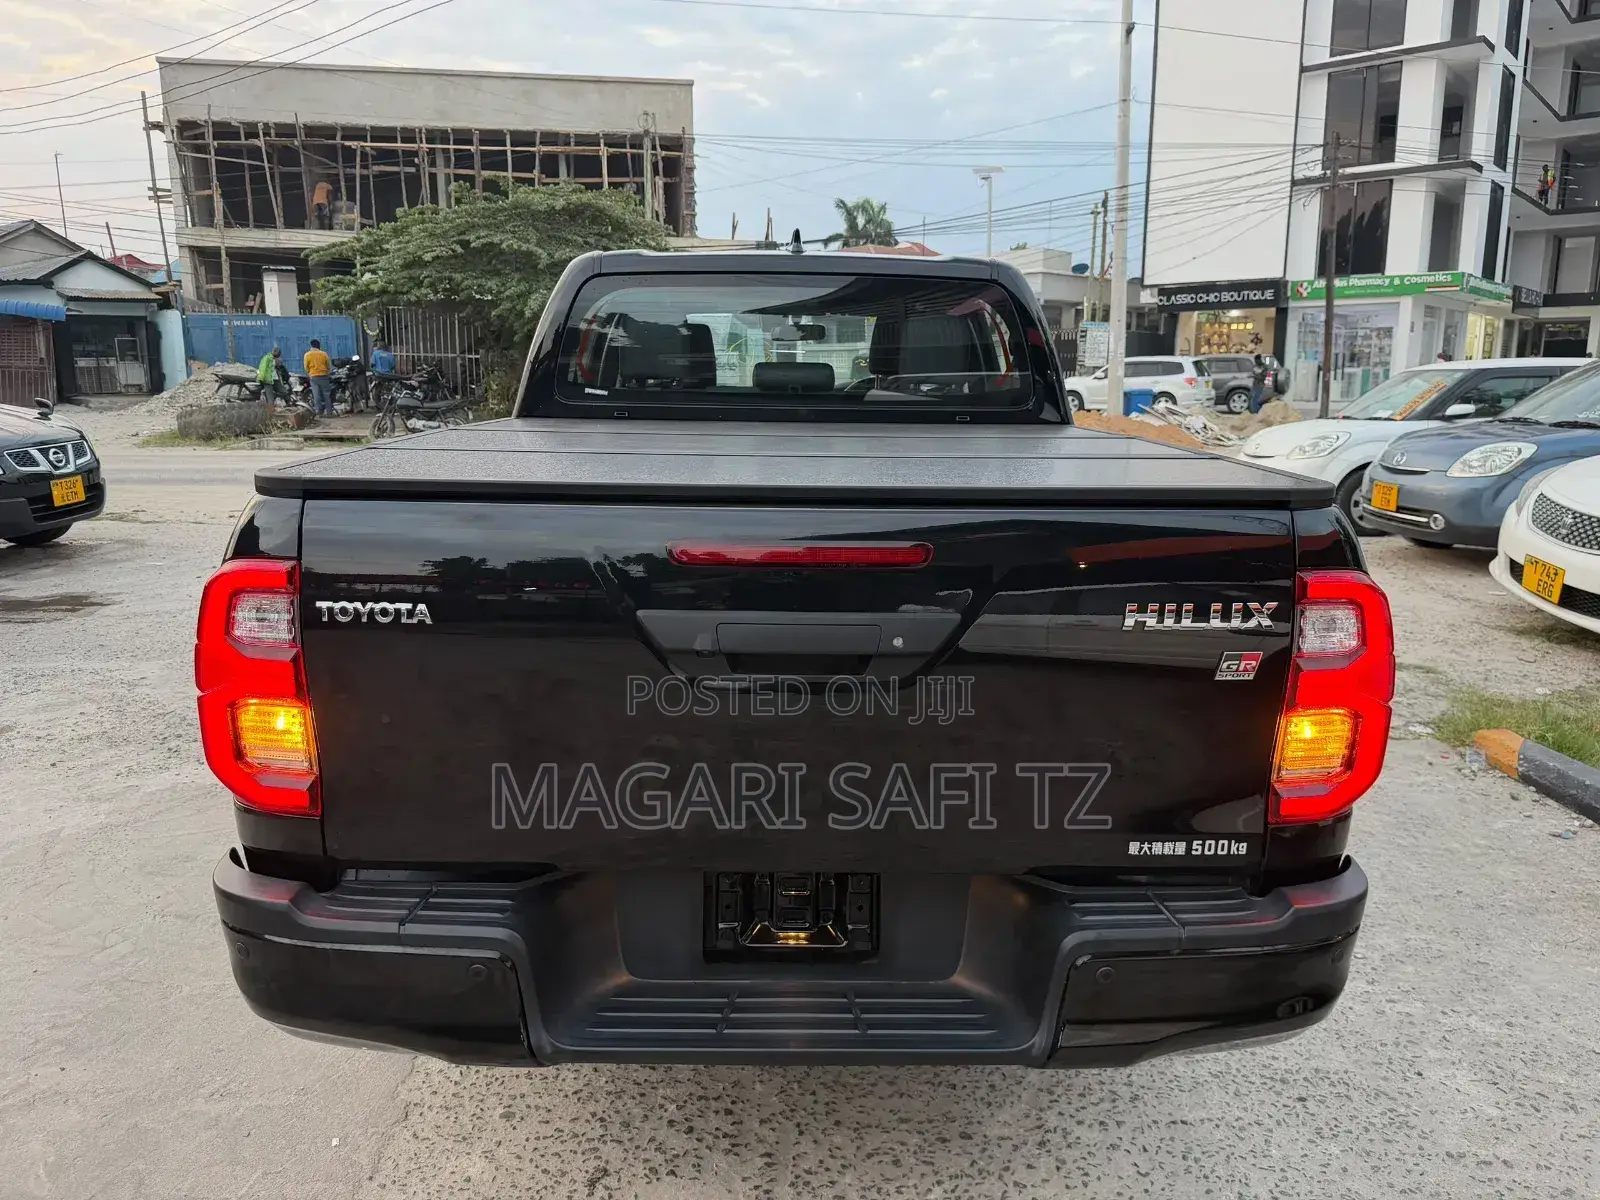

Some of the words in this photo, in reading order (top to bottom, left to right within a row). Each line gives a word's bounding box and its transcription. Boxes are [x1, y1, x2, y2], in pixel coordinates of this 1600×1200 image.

[1349, 277, 1390, 287] Pharmacy
[1393, 277, 1401, 286] &
[1403, 273, 1452, 285] Cosmetics
[1158, 293, 1196, 306] CLASSIC
[1221, 289, 1275, 302] BOUTIQUE
[1536, 578, 1554, 598] ERG
[315, 600, 433, 624] TOYOTA
[1122, 601, 1279, 631] HILUX
[1221, 660, 1257, 672] GR
[1127, 841, 1187, 856] 最大積載量
[1191, 840, 1248, 855] 500kg
